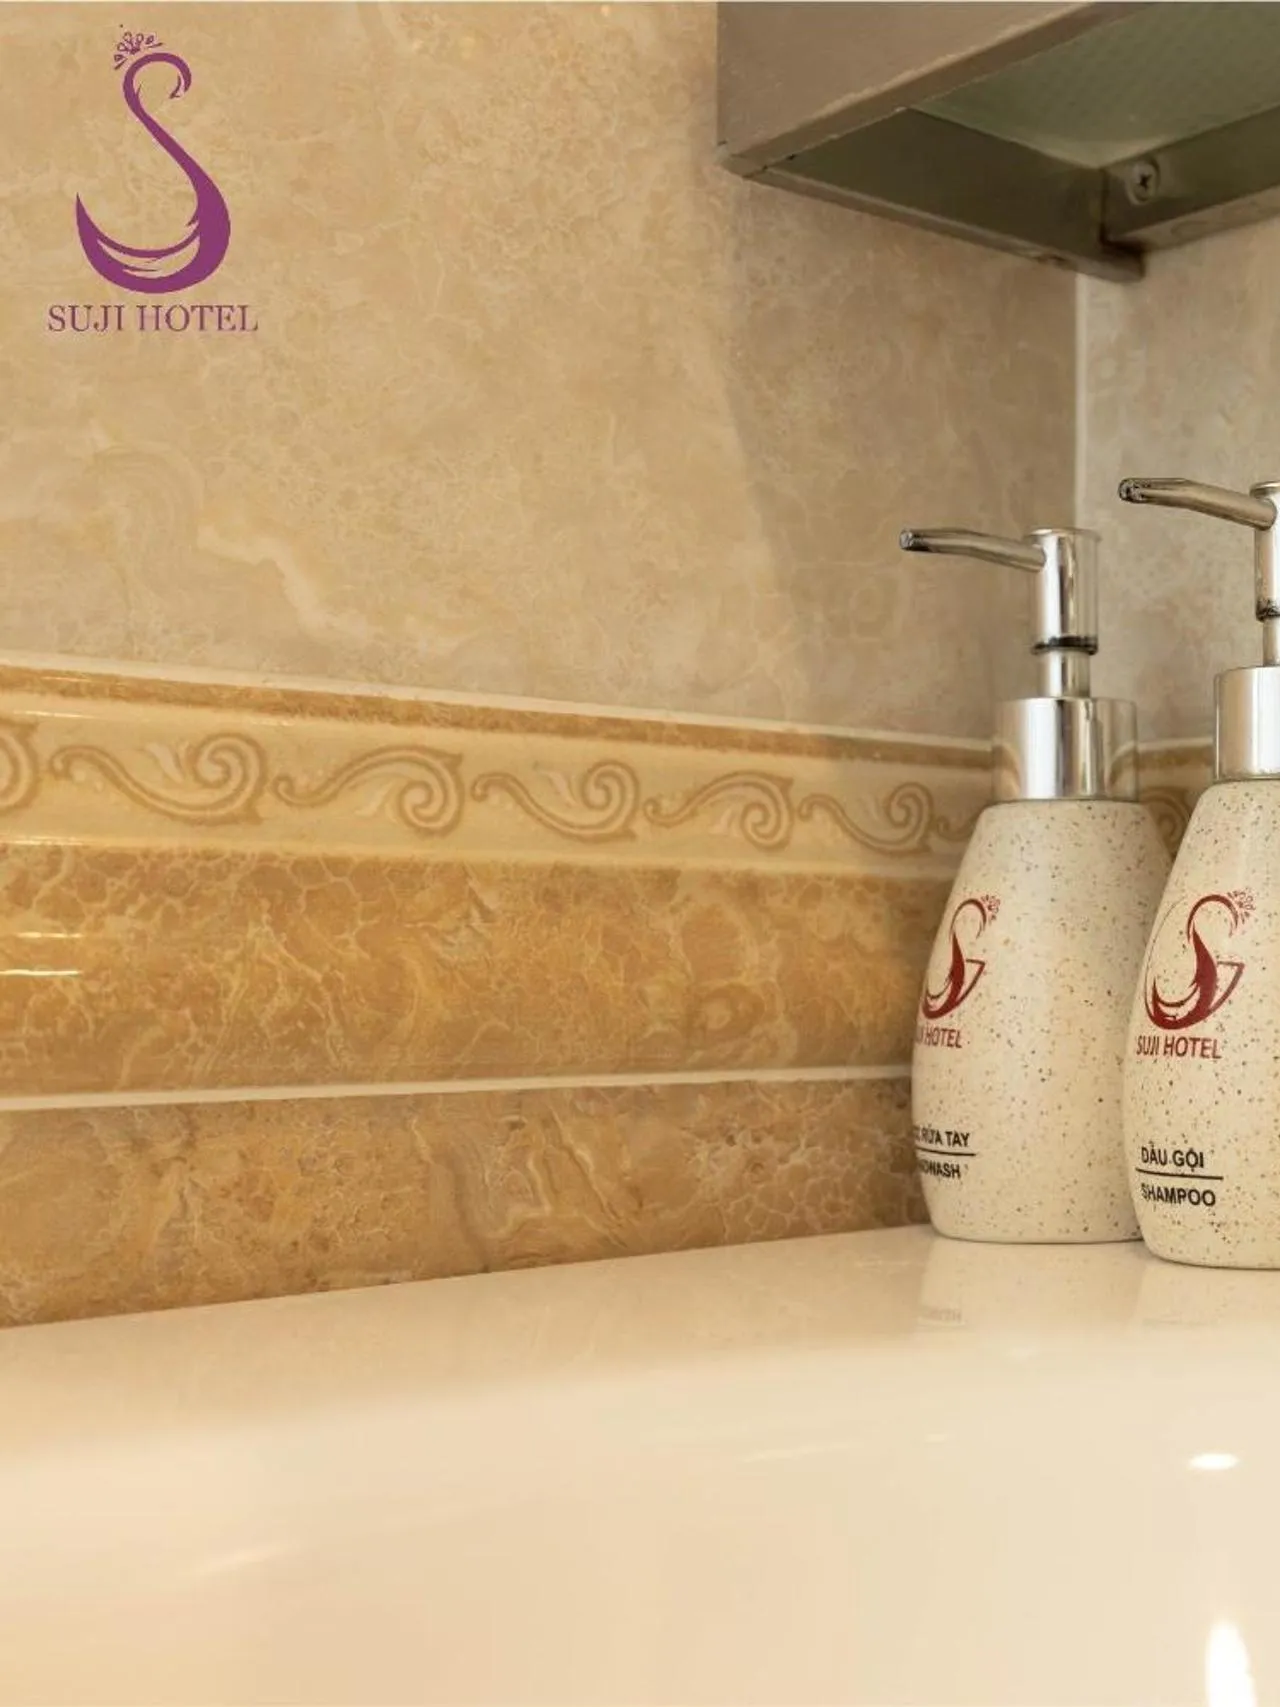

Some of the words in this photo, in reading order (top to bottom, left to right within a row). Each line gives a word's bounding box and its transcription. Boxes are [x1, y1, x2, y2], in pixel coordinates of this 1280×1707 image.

[924, 1024, 963, 1049] HOTEL
[1135, 1034, 1160, 1056] SUJI
[1163, 1034, 1222, 1059] HOTEL
[944, 1130, 970, 1147] TAY
[1141, 1183, 1216, 1207] SHAMPOO
